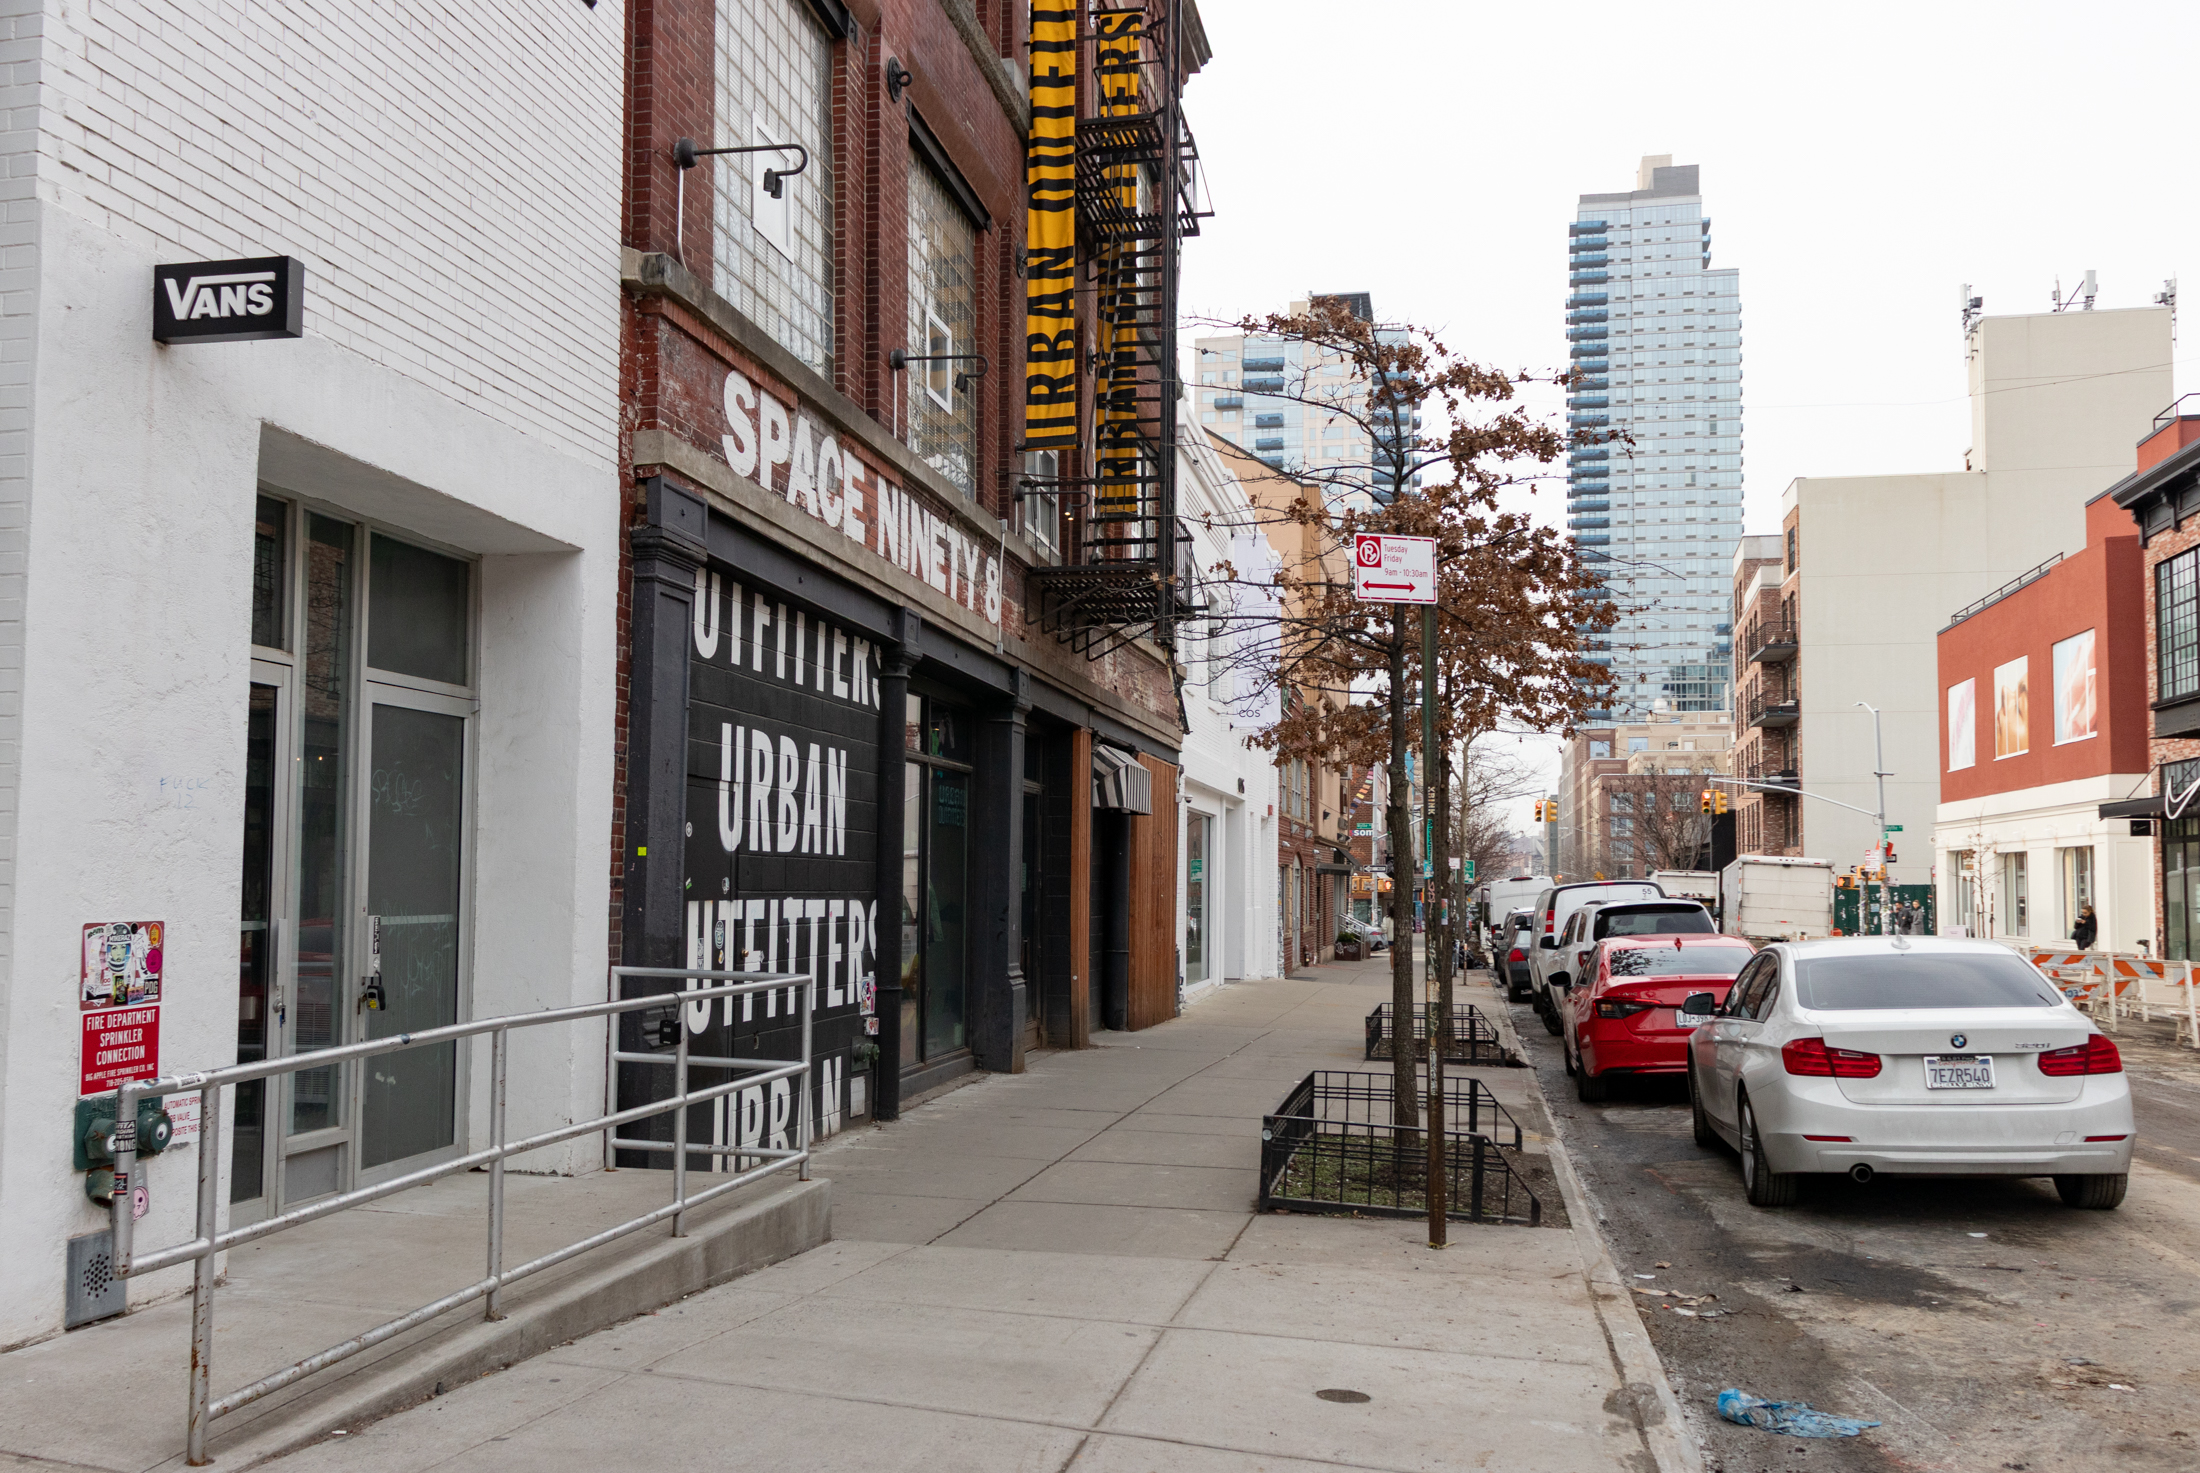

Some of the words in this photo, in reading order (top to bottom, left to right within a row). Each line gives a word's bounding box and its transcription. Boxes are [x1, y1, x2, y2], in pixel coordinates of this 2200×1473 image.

[164, 271, 276, 320] VANS
[1025, 246, 1076, 447] URBAN
[722, 369, 866, 546] SPACE
[877, 472, 980, 611] NINETY
[985, 556, 1000, 624] 8
[1384, 544, 1408, 555] Tuesday
[1384, 554, 1402, 564] Friday
[1384, 568, 1398, 576] 9am
[1403, 569, 1428, 578] 10:30am
[160, 775, 209, 793] FUCK
[718, 722, 846, 857] URBAN
[144, 980, 158, 994] PDG
[86, 1015, 105, 1031] FIRE
[107, 1009, 156, 1028] DEPARTMENT
[100, 1028, 143, 1047] SPRINKLER
[96, 1045, 145, 1066] CONNECTION
[94, 1071, 106, 1079] APPLE
[107, 1069, 116, 1077] FIRE
[117, 1065, 139, 1076] SPRINKLER
[1930, 1068, 1990, 1083] 7EZR540
[164, 1097, 188, 1110] AUTOMATIC
[177, 1112, 190, 1122] VALVE
